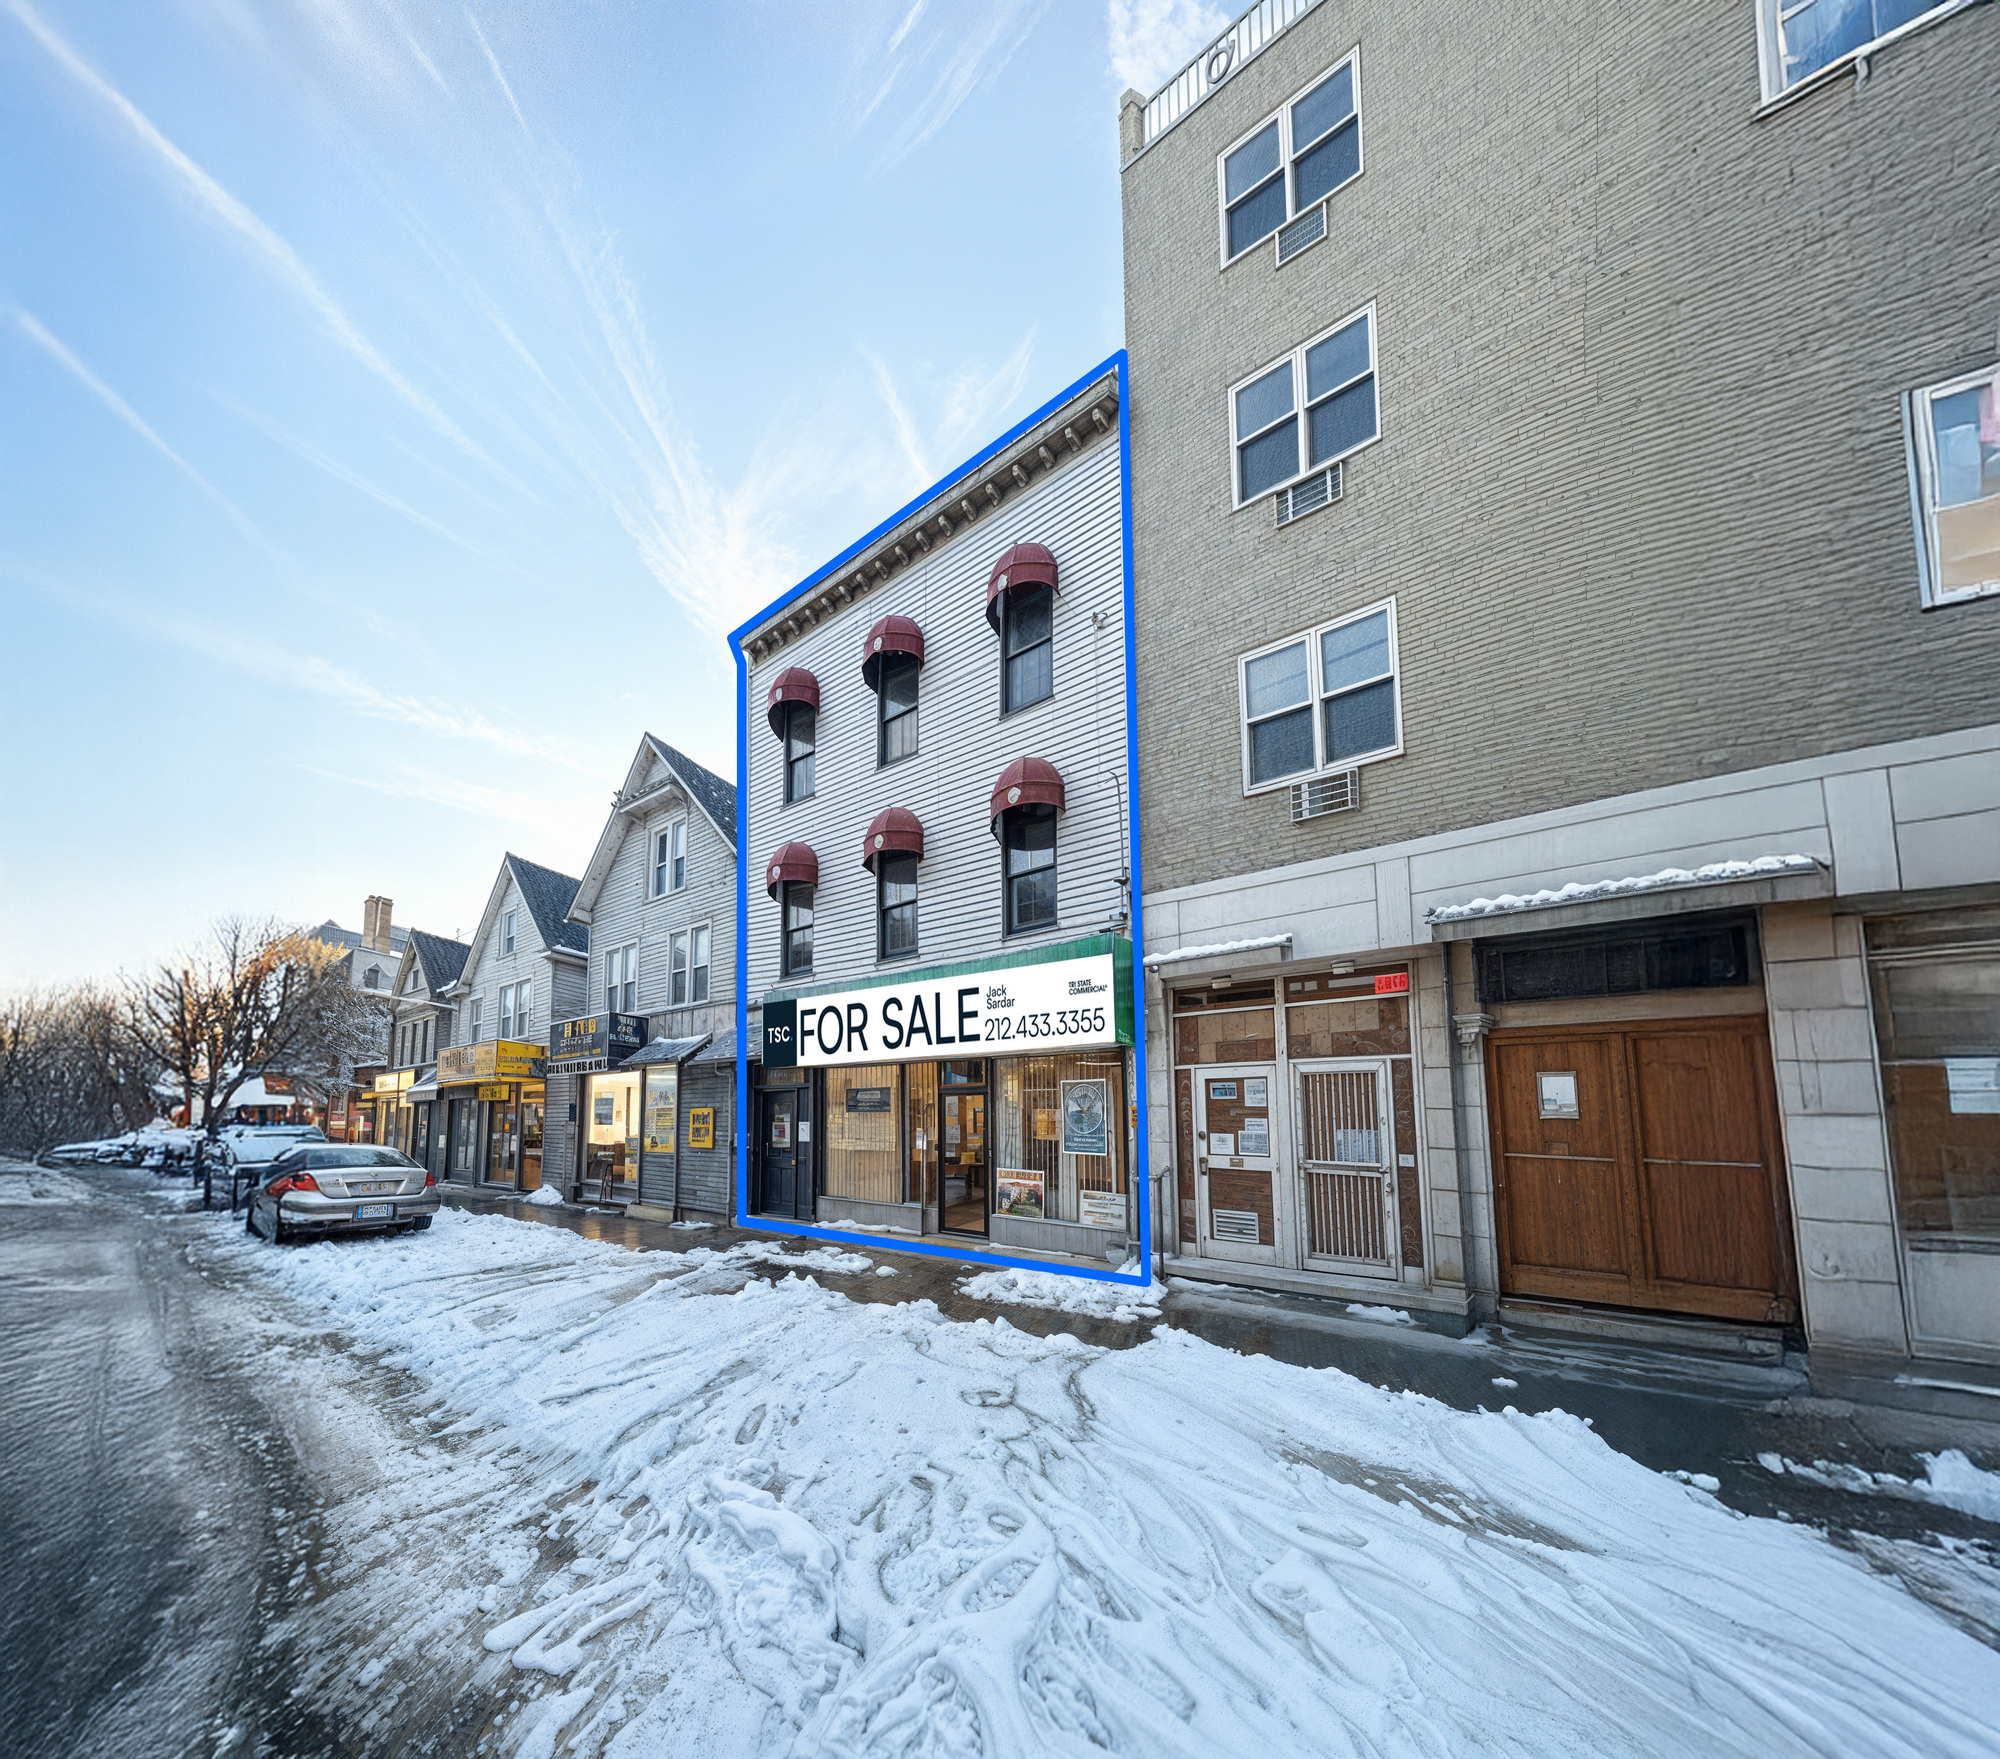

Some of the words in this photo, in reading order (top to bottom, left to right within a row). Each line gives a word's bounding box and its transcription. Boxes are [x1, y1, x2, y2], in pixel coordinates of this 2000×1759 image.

[1077, 979, 1092, 987] STATE
[986, 984, 1007, 998] Jack
[986, 996, 1015, 1010] Sardar
[800, 1002, 868, 1056] FOR
[882, 986, 980, 1050] SALE
[985, 1007, 1105, 1041] 212.433.3355
